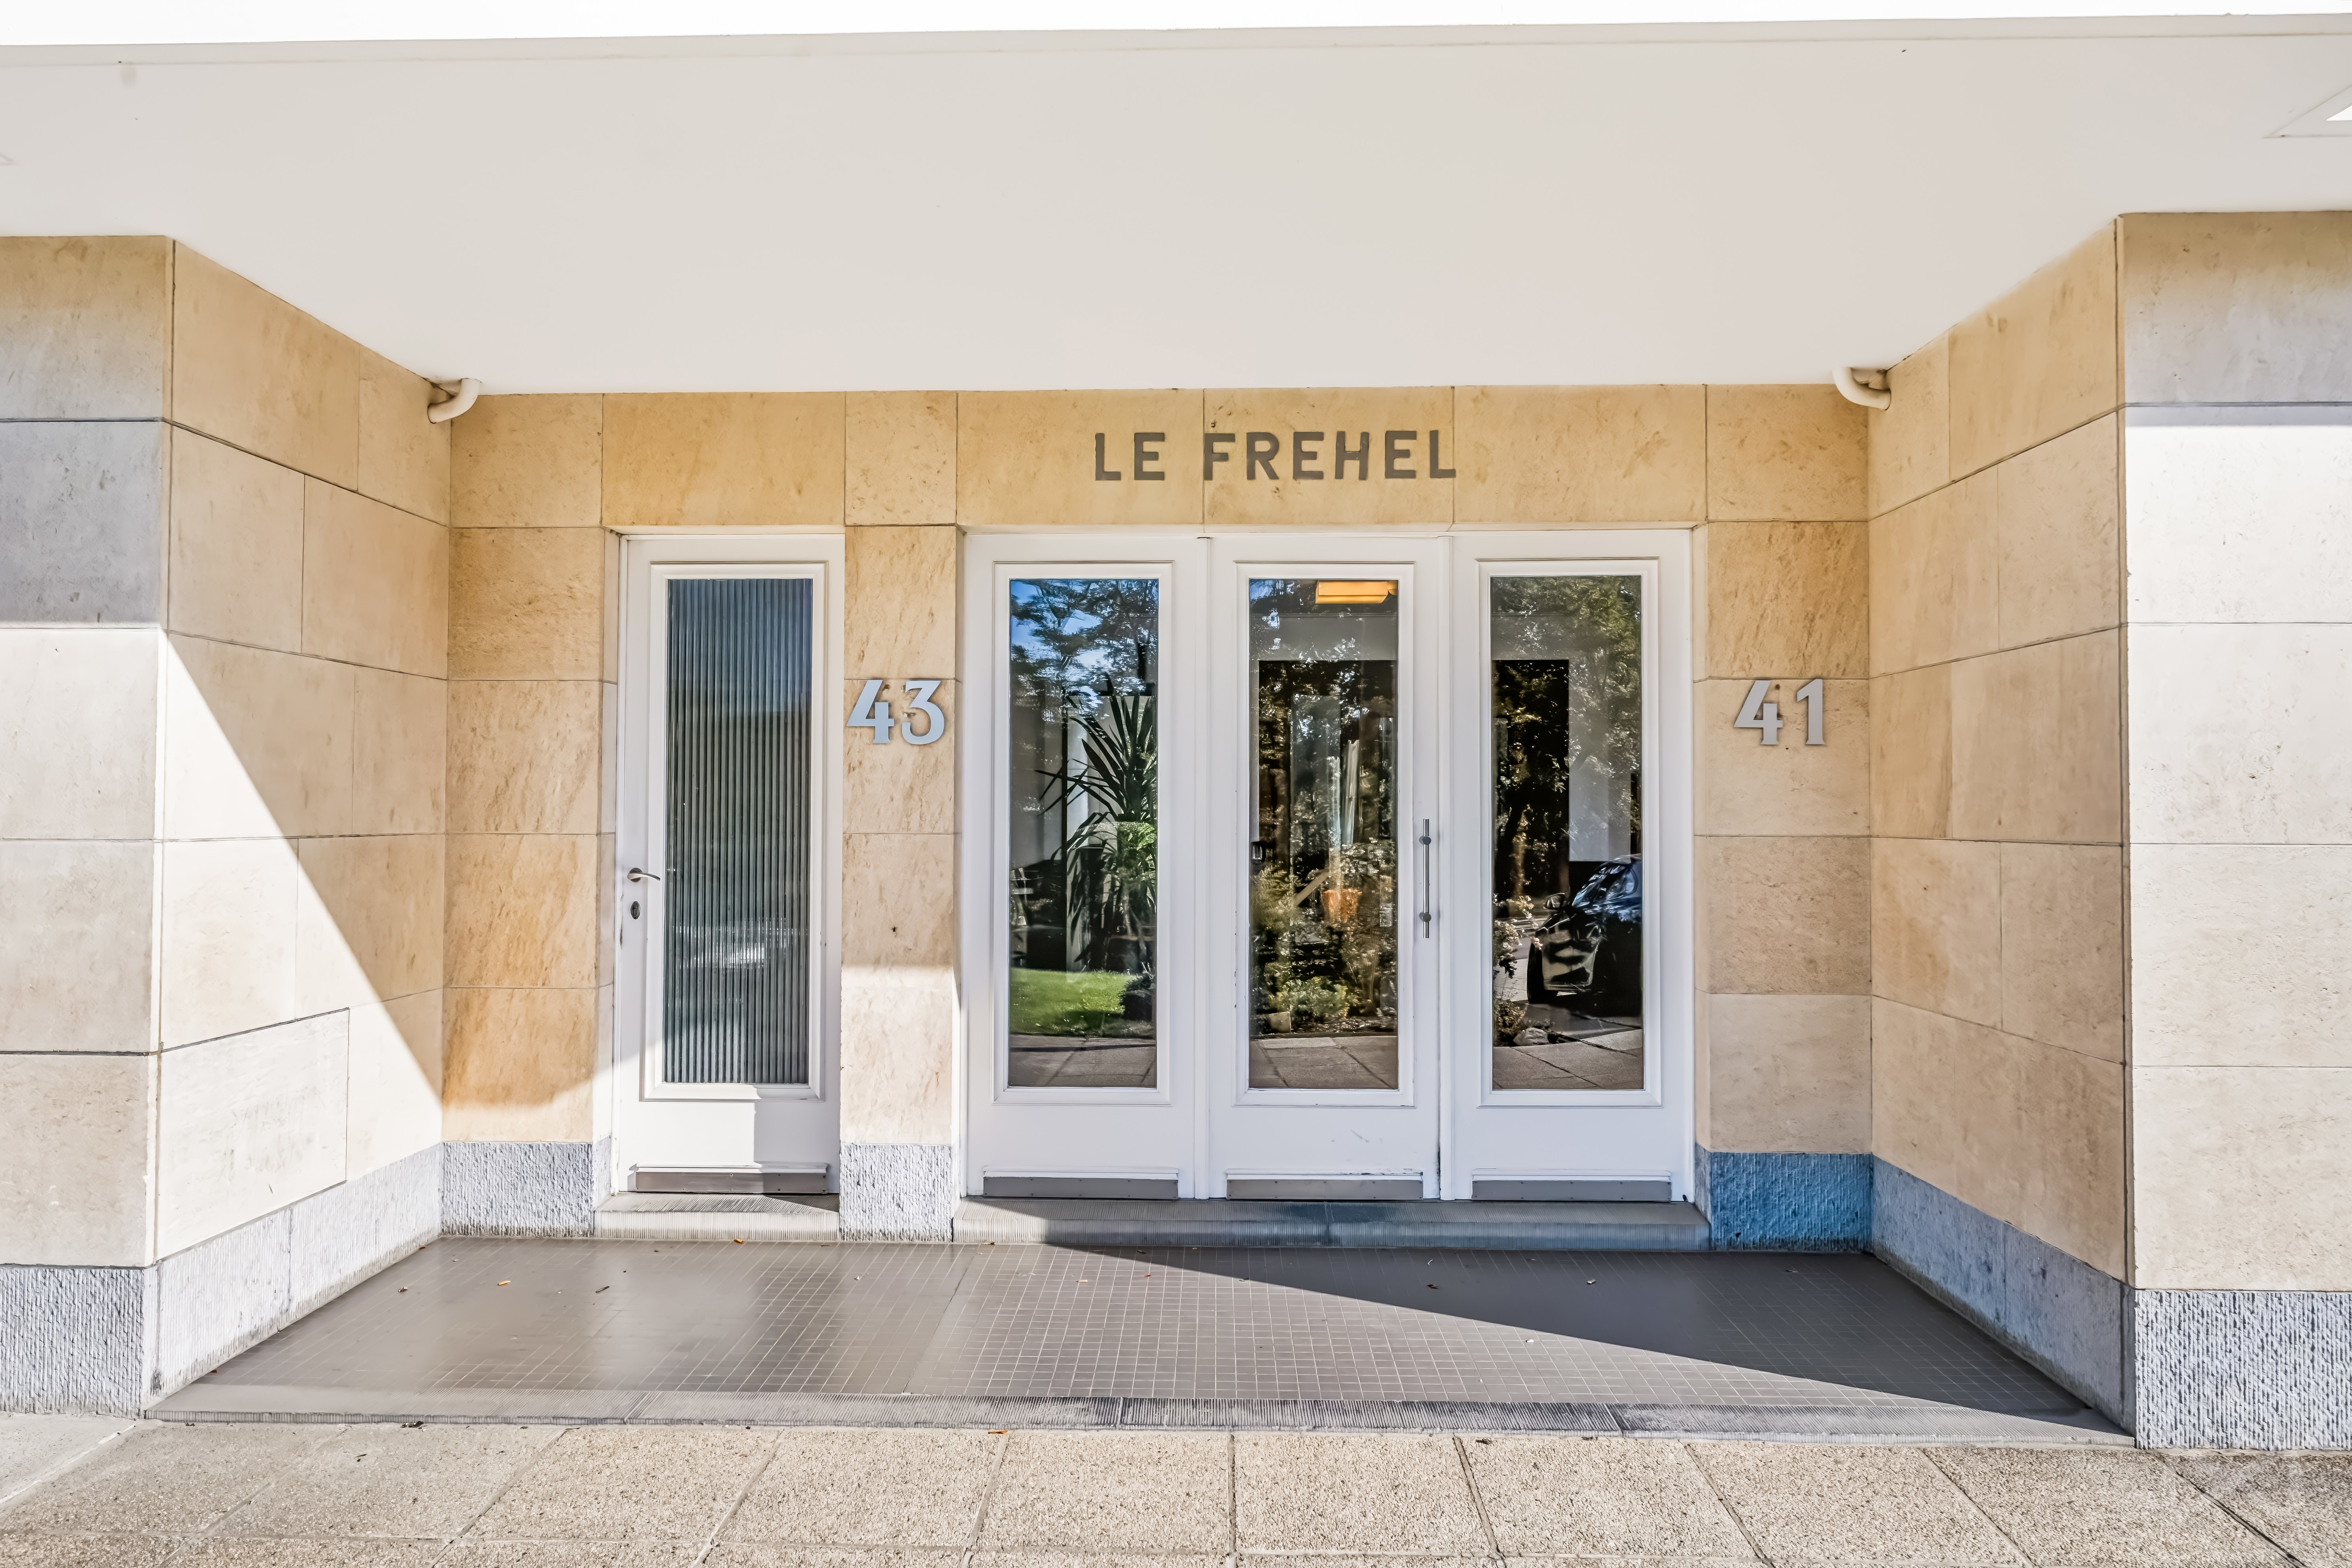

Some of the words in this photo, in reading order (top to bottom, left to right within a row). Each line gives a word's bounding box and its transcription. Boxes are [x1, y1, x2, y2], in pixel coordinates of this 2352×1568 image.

[1095, 432, 1165, 481] LE
[1204, 430, 1456, 481] FREHEL
[846, 679, 944, 745] 43
[1734, 679, 1825, 745] 41
